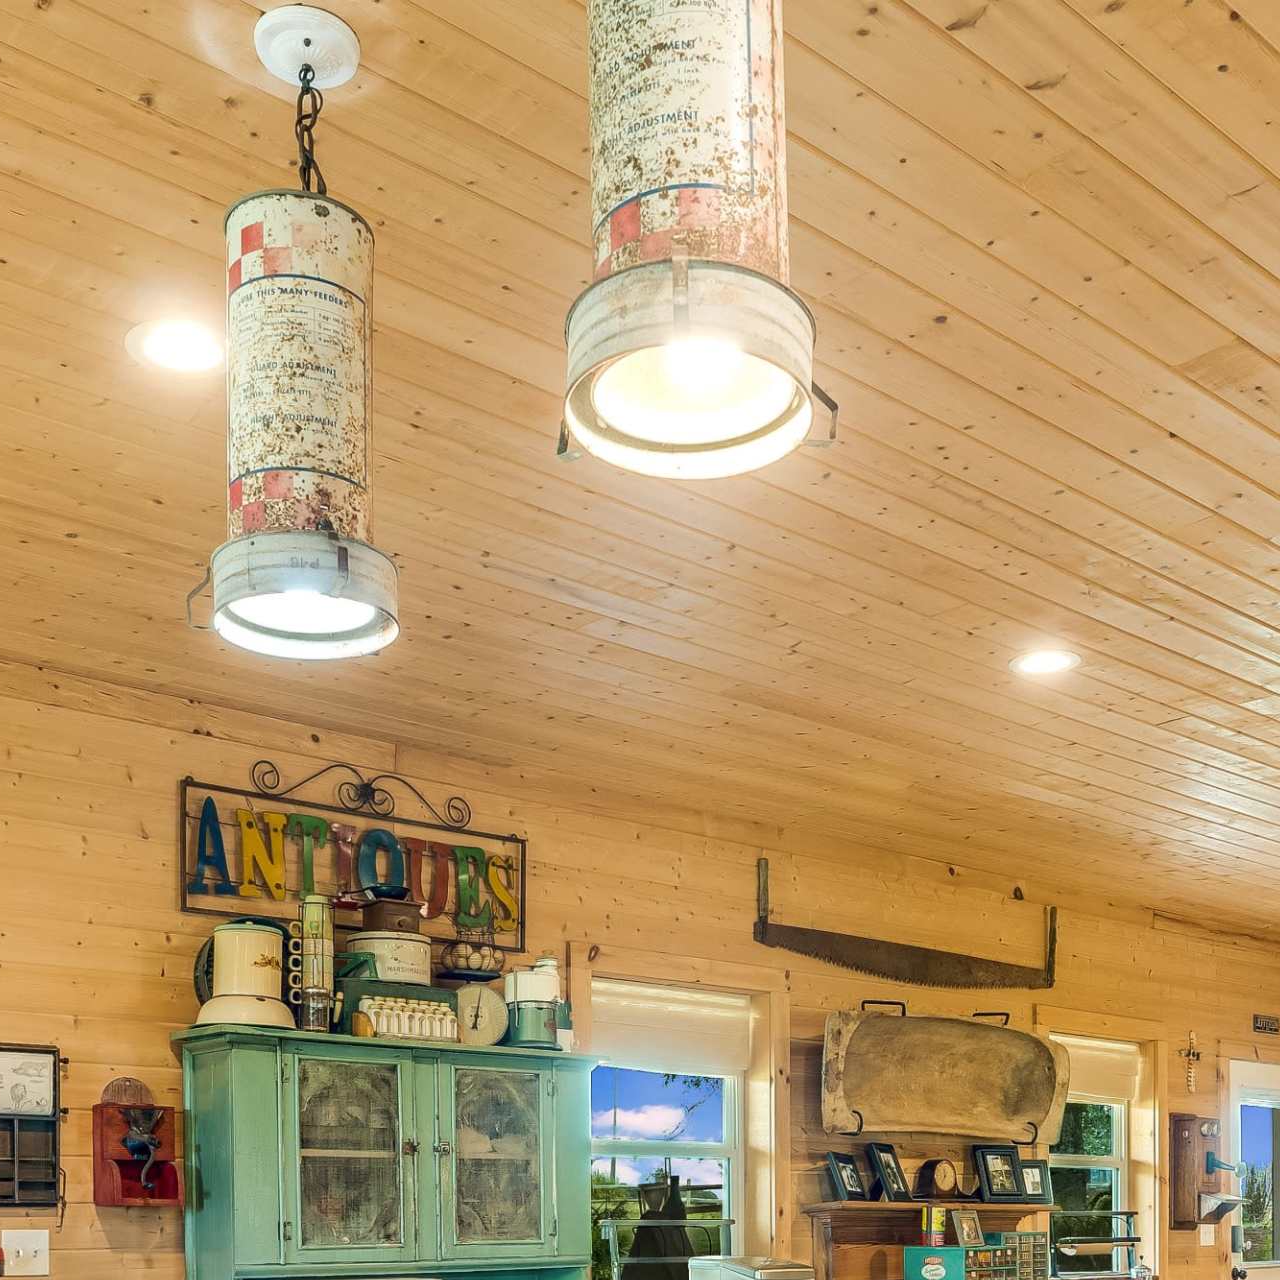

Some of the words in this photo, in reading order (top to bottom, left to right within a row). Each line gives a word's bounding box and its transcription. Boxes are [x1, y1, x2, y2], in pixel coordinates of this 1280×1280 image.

[257, 287, 275, 297] THIS
[279, 287, 309, 296] MANY
[187, 796, 519, 932] ANTIQUES
